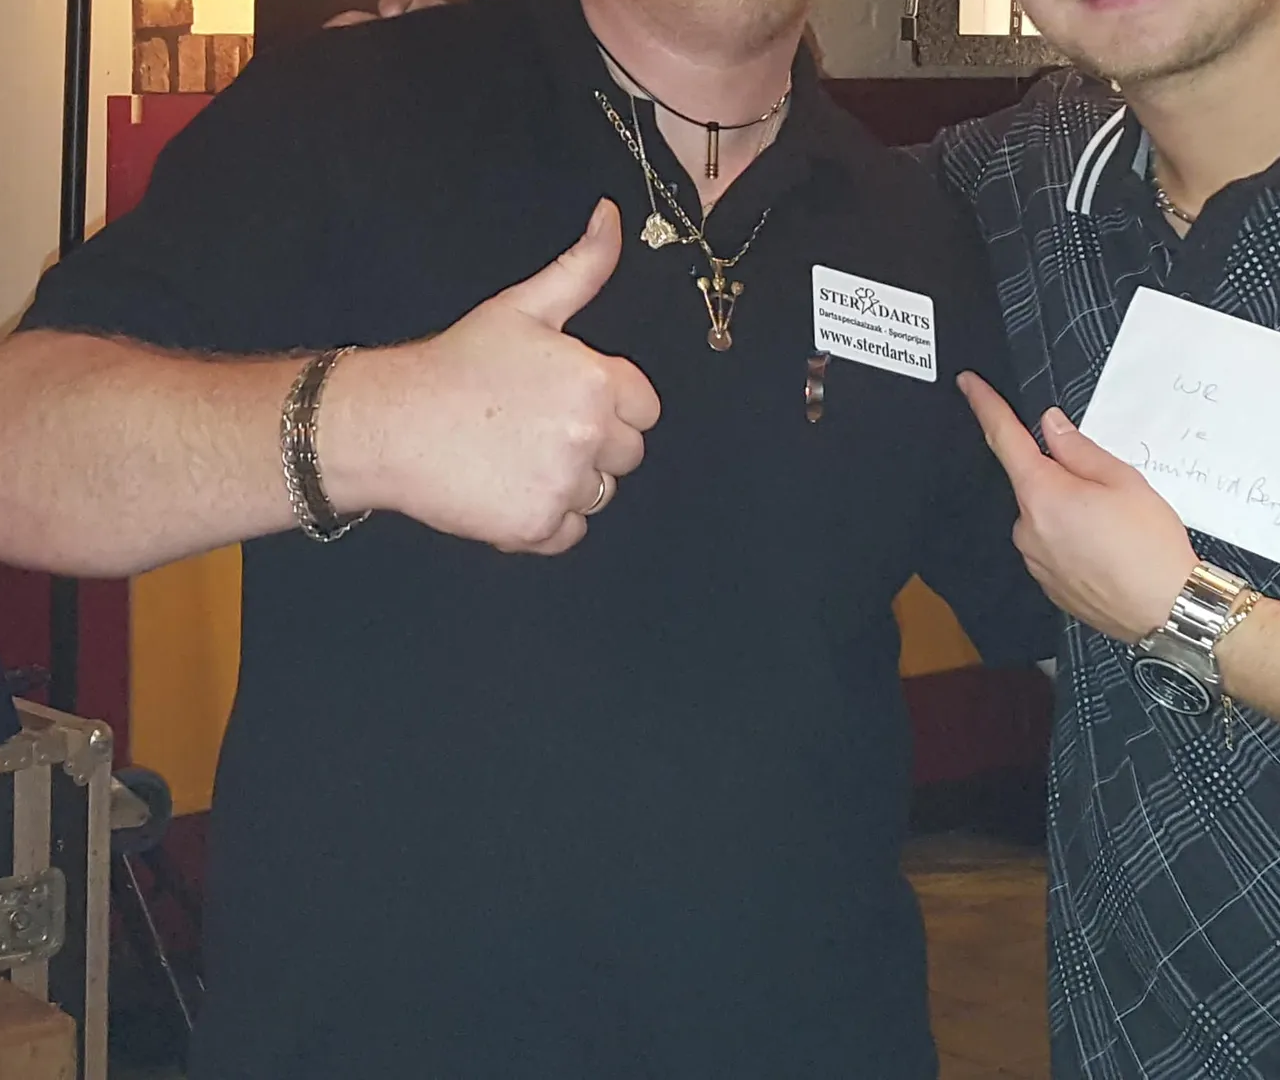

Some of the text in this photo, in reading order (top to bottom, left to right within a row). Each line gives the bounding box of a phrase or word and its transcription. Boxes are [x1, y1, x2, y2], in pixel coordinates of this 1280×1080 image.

[820, 287, 930, 331] STER DARTS
[820, 328, 932, 369] www.sterdarts.nl
